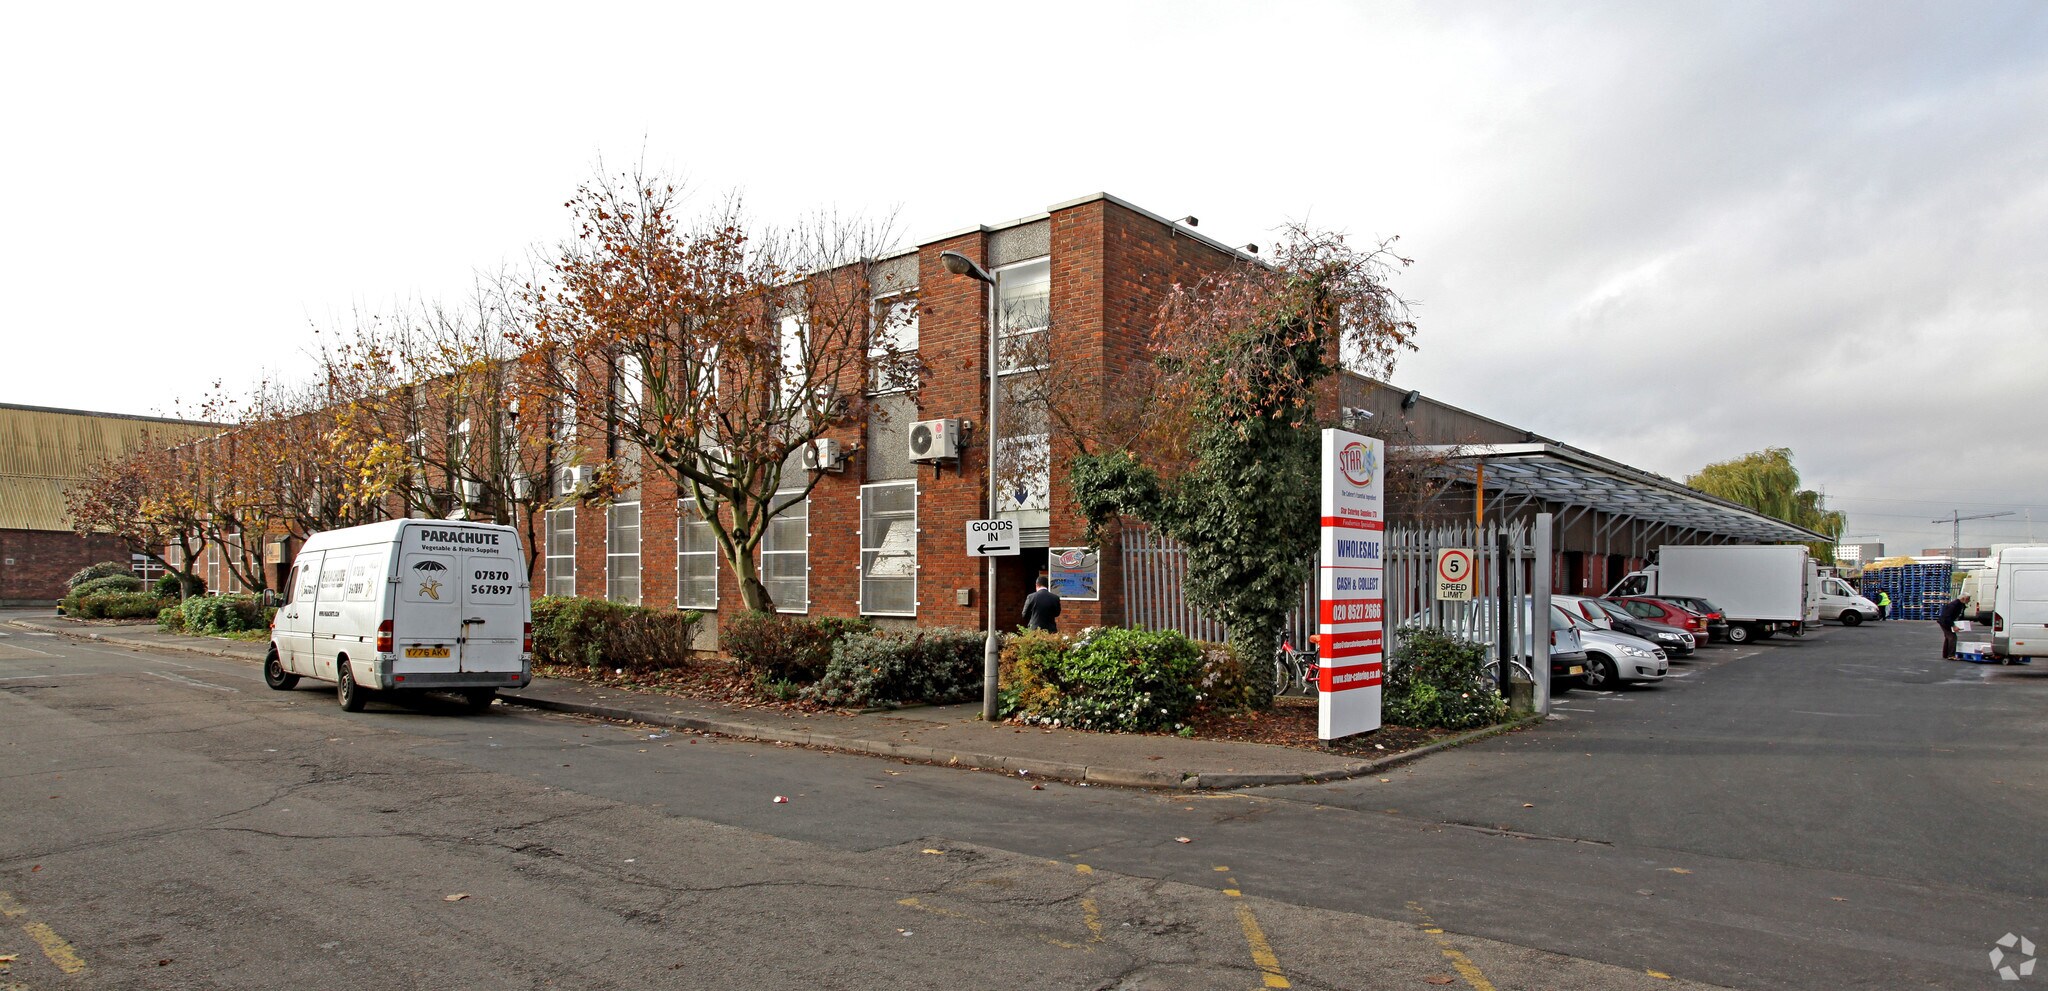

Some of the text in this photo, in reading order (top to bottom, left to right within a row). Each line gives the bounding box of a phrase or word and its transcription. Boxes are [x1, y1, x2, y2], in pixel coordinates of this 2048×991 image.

[1339, 450, 1362, 472] STAR
[972, 520, 1013, 531] GOODS
[421, 530, 499, 545] PARACHUTE
[987, 532, 999, 542] IN
[421, 544, 451, 552] Vegetable
[1337, 539, 1379, 559] WHOLESALE
[1450, 560, 1459, 573] 5
[474, 570, 509, 581] 07870
[471, 584, 513, 595] 567897
[1336, 577, 1379, 591] CASH & COLLECT
[1440, 583, 1467, 591] SPEED
[1333, 603, 1381, 621] 020 8527 2666
[406, 648, 449, 656] Y776 AKV
